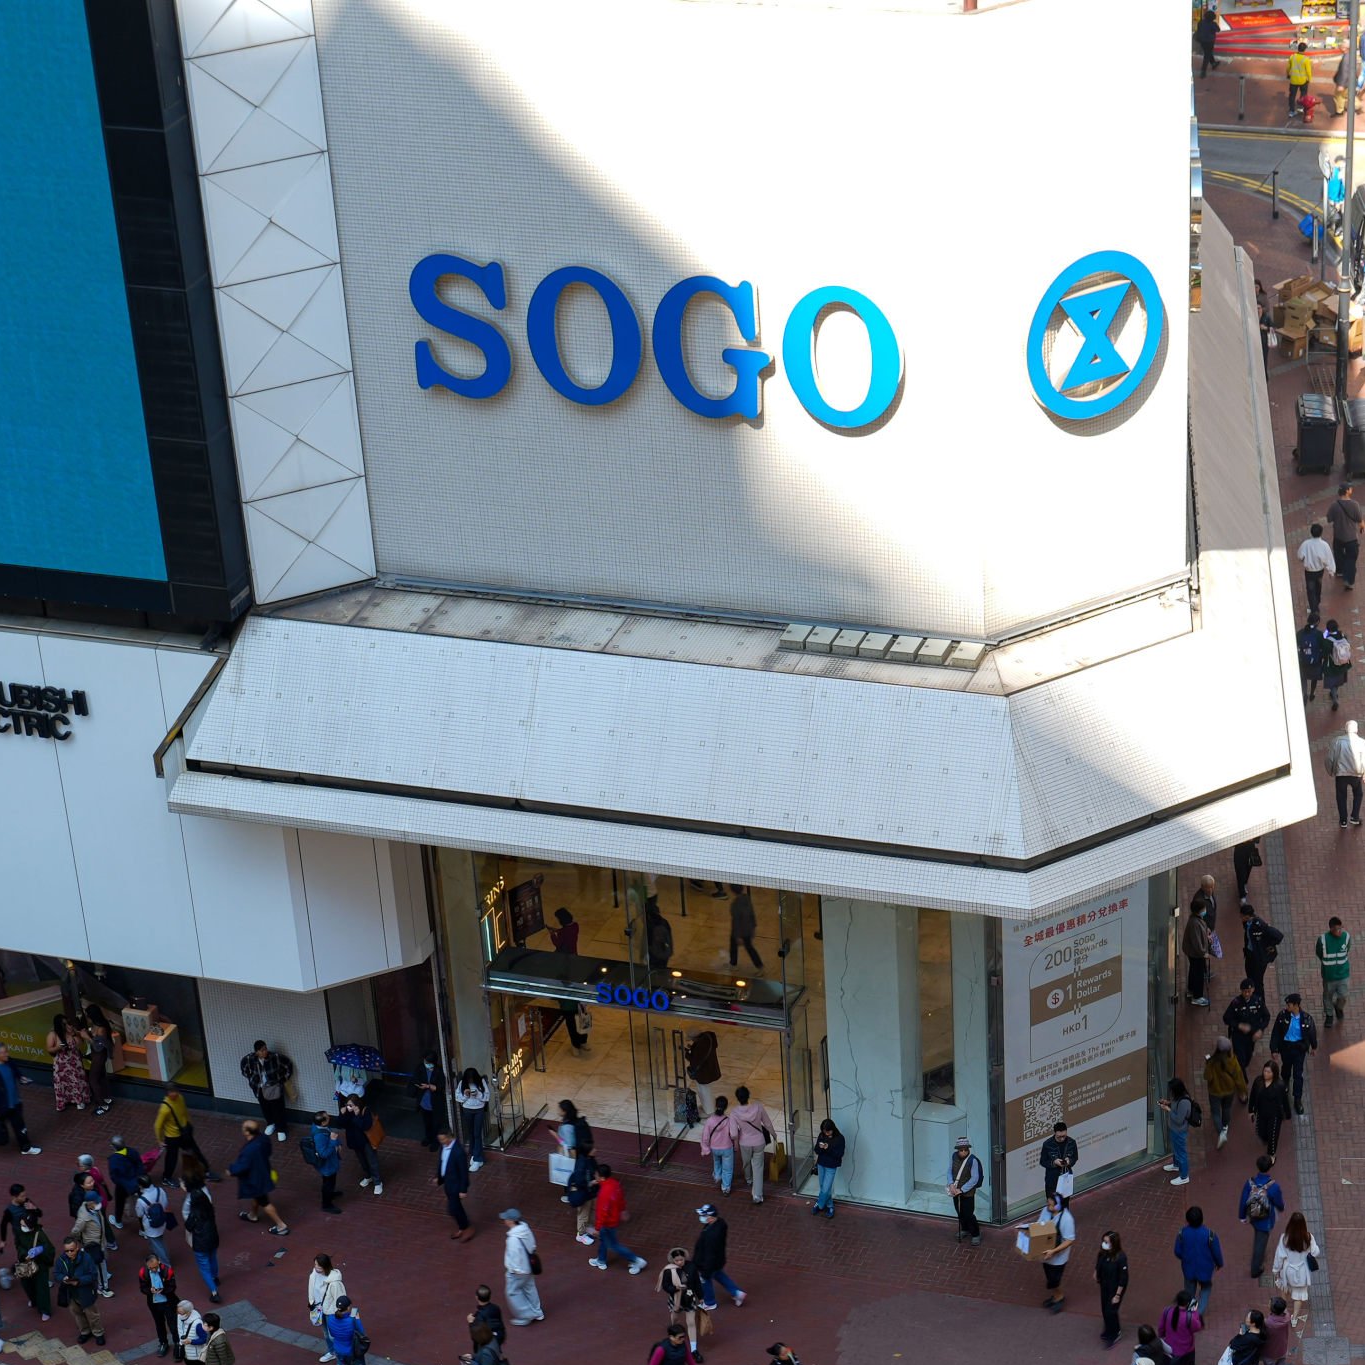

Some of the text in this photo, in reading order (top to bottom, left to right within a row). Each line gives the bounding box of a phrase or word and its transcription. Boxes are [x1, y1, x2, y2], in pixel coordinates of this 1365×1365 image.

[409, 253, 901, 428] SOGO
[1023, 898, 1129, 948] 全城最優惠積分兌換率
[1073, 933, 1096, 948] SOGO
[1073, 938, 1108, 957] Rewards
[1044, 946, 1072, 971] 200
[1076, 969, 1112, 989] Rewards
[596, 982, 670, 1011] SOGO
[1076, 984, 1102, 1000] Dollar
[10, 1032, 33, 1042] CWB
[1062, 1022, 1081, 1036] HKD
[7, 1044, 24, 1053] KAI
[25, 1046, 44, 1055] TAK
[1088, 1045, 1100, 1054] The
